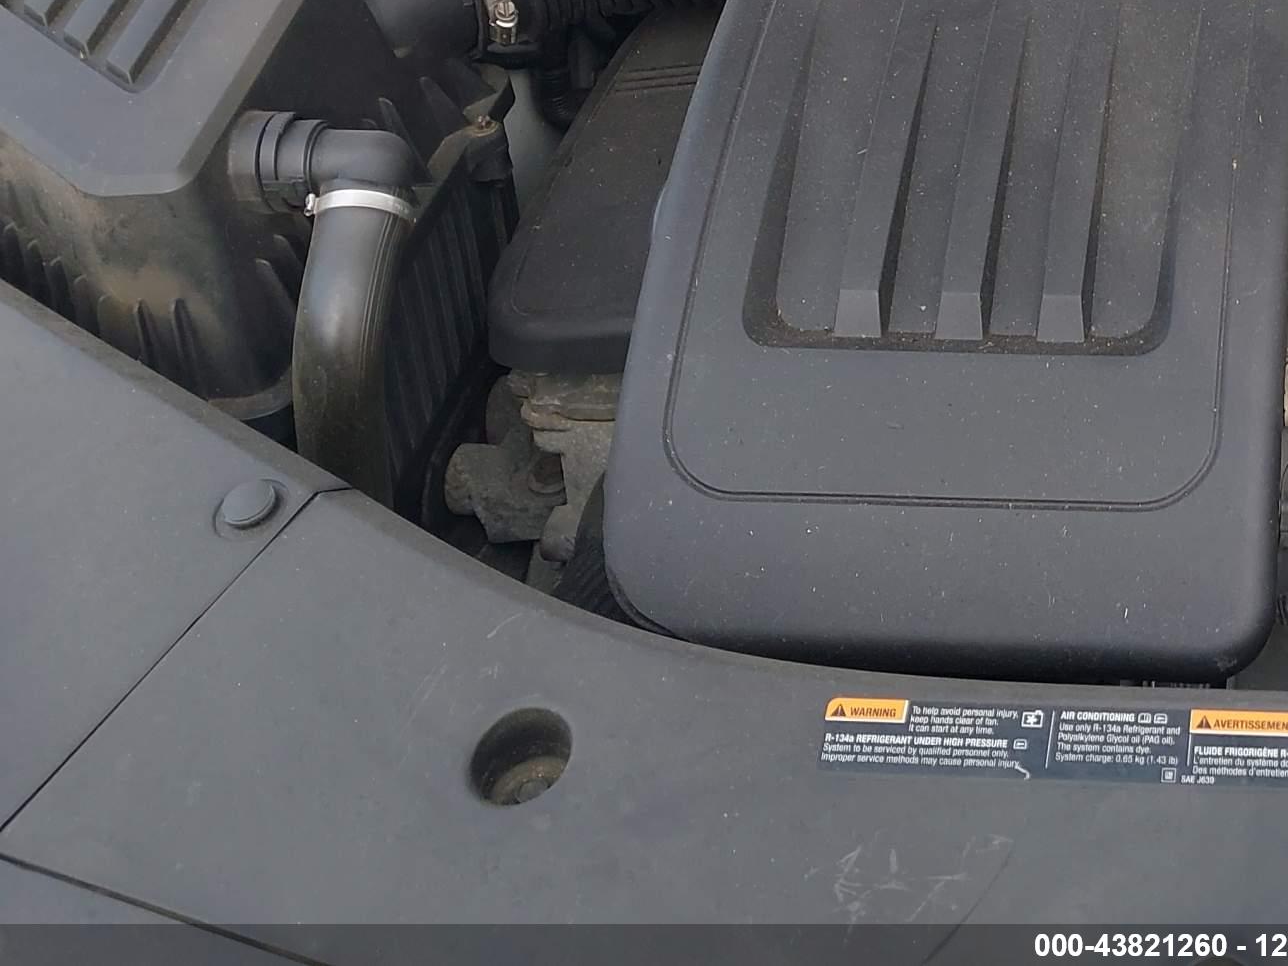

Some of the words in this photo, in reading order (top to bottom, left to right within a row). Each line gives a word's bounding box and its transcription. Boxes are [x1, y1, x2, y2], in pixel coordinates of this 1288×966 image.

[850, 706, 896, 717] WARNING
[913, 705, 921, 714] To
[923, 706, 939, 716] help
[941, 707, 961, 715] avoid
[962, 708, 994, 717] personal
[1060, 711, 1075, 720] AIR
[1077, 712, 1135, 722] CONDITIONING
[910, 715, 928, 724] keep
[931, 715, 953, 724] hands
[955, 716, 973, 725] clear
[975, 717, 983, 725] of
[950, 725, 958, 733] at
[960, 727, 974, 736] any
[1059, 722, 1073, 731] Use
[1075, 723, 1090, 733] only
[1093, 724, 1121, 732] R-134a
[1123, 725, 1164, 735] Refrigerant
[1166, 727, 1180, 735] and
[825, 733, 854, 743] R-134a
[856, 734, 912, 745] REFRIGERANT
[914, 736, 941, 746] UNDER
[943, 737, 963, 747] HIGH
[965, 738, 1008, 748] PRESSURE
[1058, 732, 1104, 742] Polyalkylene
[1106, 734, 1129, 744] Glycol
[1131, 735, 1140, 743] oil
[1142, 735, 1160, 745] (PAG
[823, 743, 851, 752] System
[853, 744, 860, 752] to
[862, 744, 872, 752] be
[874, 745, 906, 753] serviced
[907, 746, 916, 756] by
[918, 747, 951, 756] qualified
[952, 748, 990, 757] personnel
[1057, 742, 1071, 751] The
[1073, 743, 1100, 753] system
[1102, 744, 1134, 753] contains
[1194, 746, 1222, 756] FLUIDE
[821, 753, 855, 762] Improper
[857, 754, 884, 762] service
[886, 755, 919, 764] methods
[920, 757, 937, 766] may
[963, 758, 996, 767] personal
[1055, 752, 1083, 762] System
[1135, 755, 1144, 765] kg
